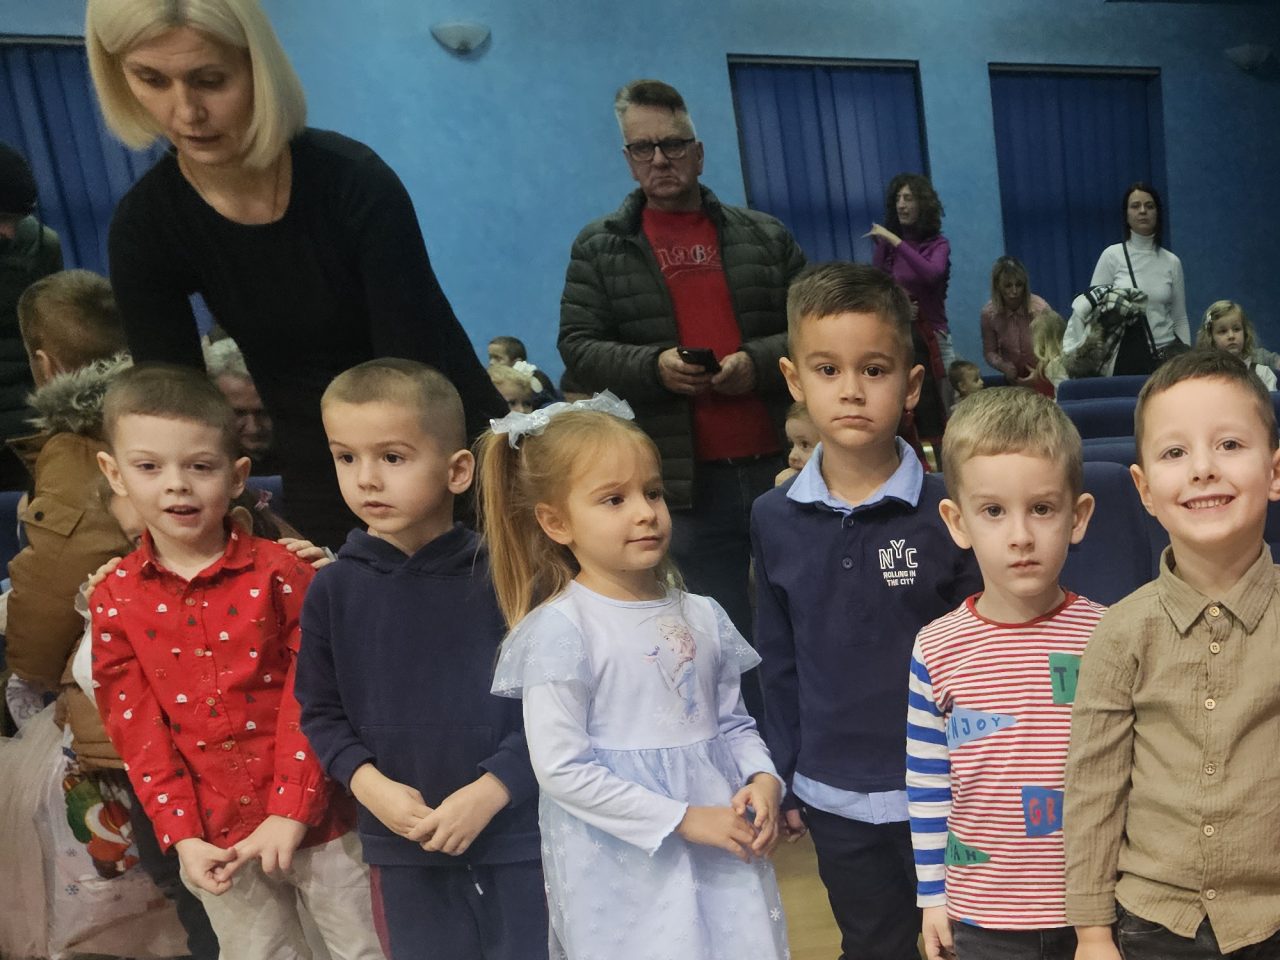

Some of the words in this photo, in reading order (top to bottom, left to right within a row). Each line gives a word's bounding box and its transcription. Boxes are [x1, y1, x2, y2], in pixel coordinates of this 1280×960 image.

[879, 539, 918, 569] NYC
[883, 571, 908, 579] ROLLING
[887, 579, 899, 587] THE
[947, 715, 1000, 739] NJOY
